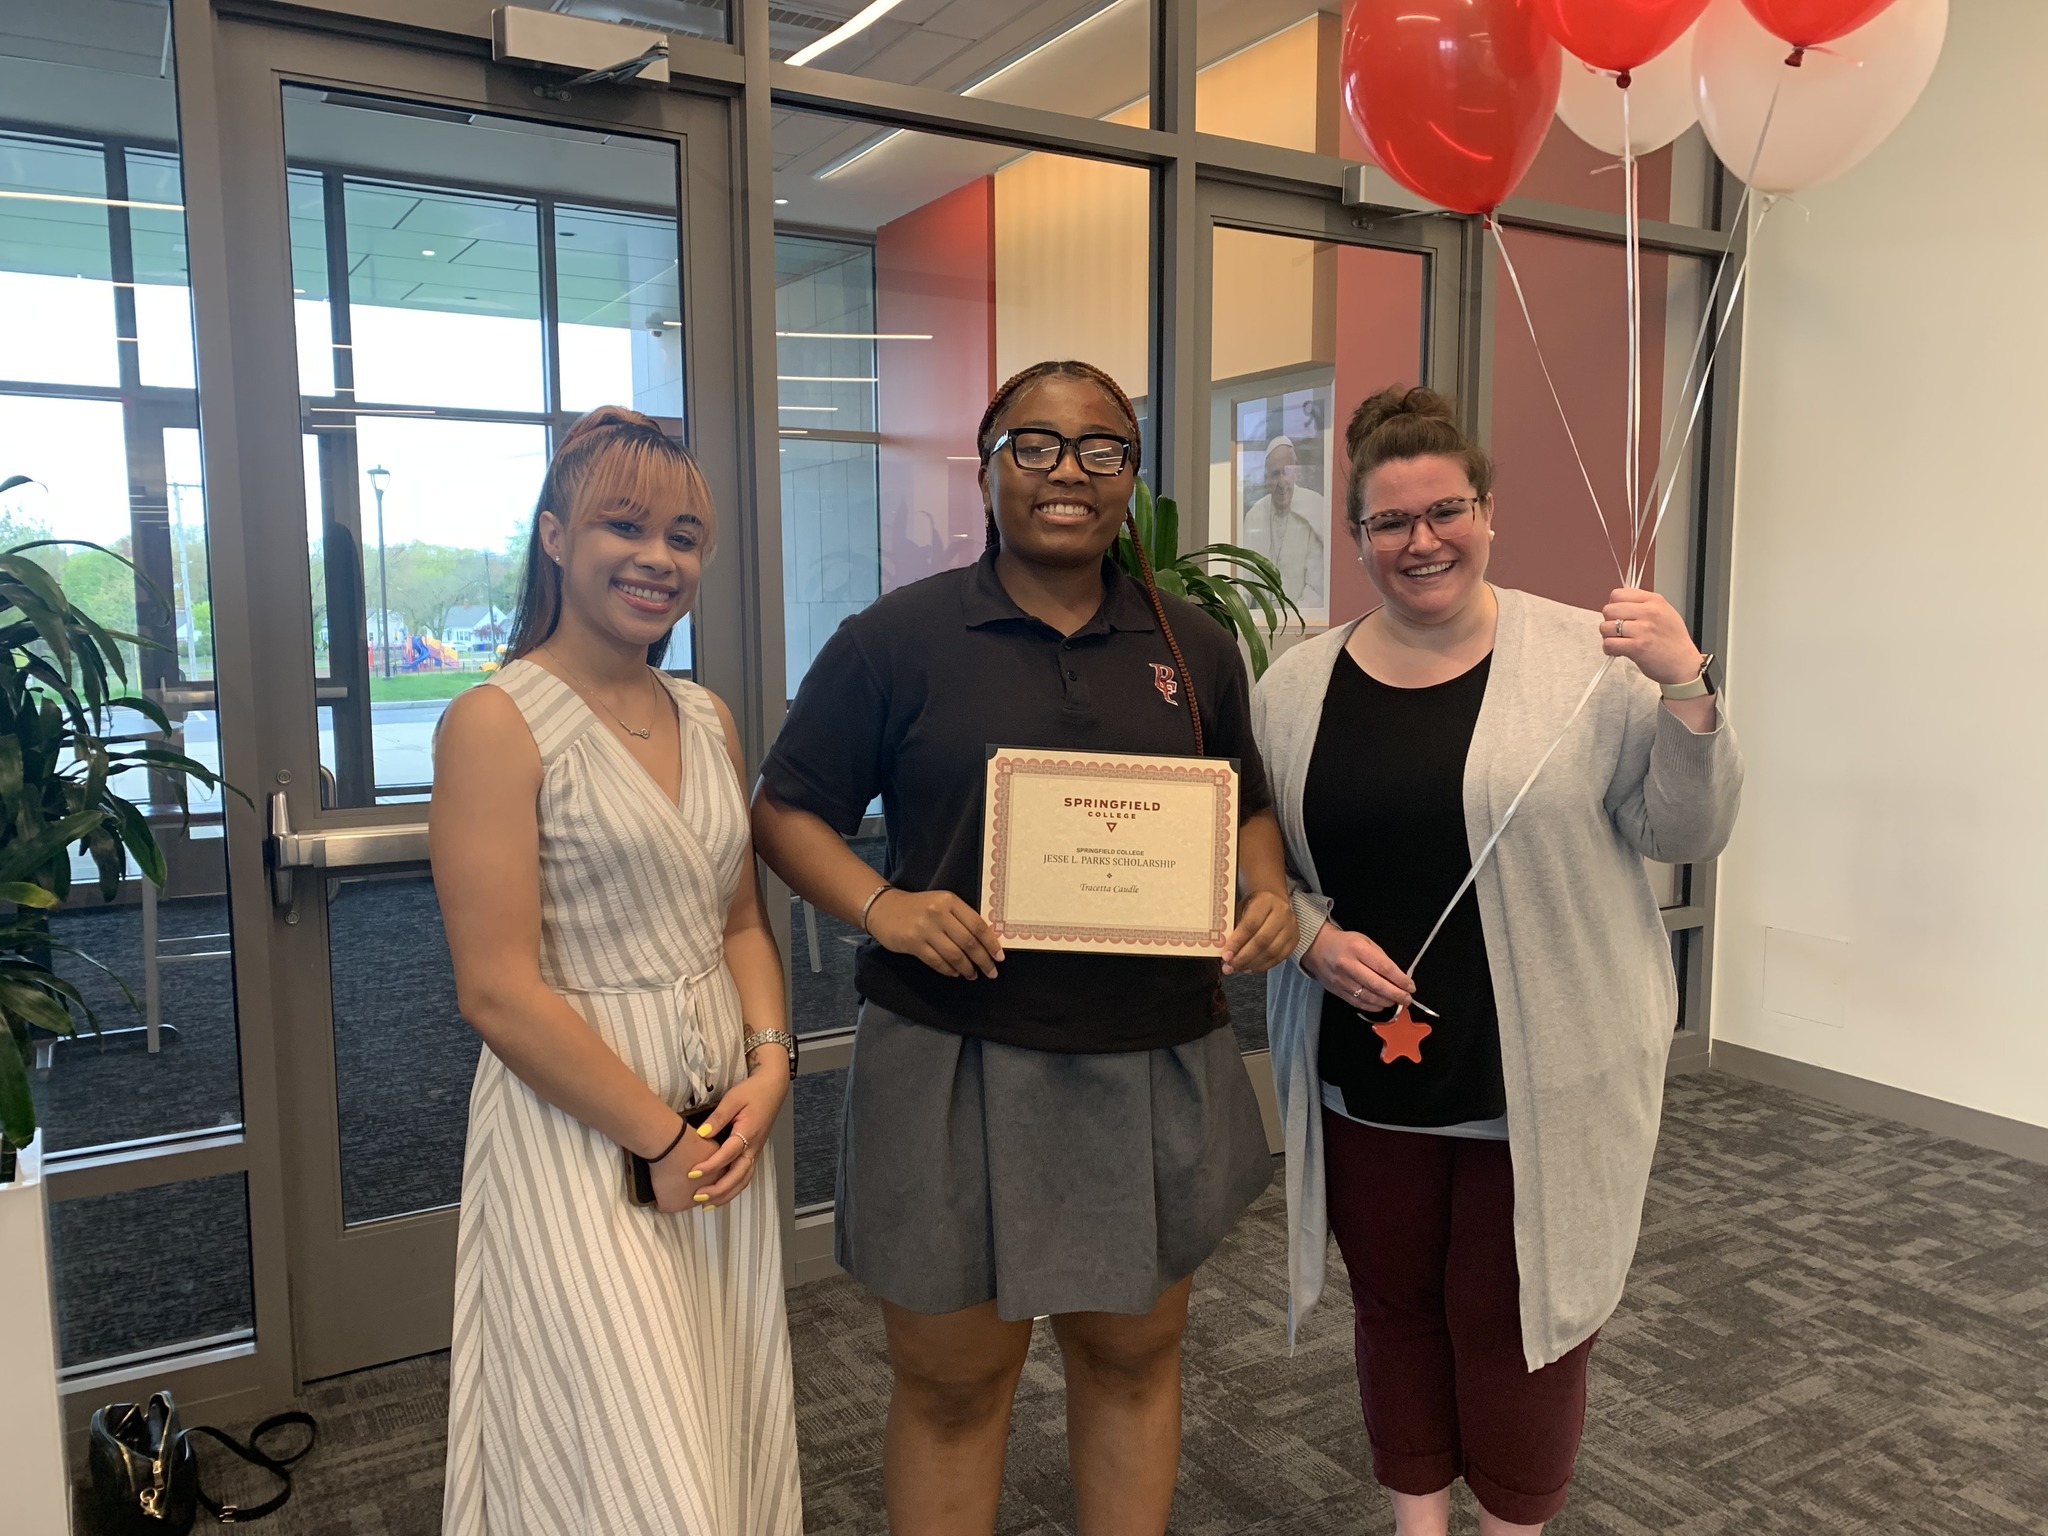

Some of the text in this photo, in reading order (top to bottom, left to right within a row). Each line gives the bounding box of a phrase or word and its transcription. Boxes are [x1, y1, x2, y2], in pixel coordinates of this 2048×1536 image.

[1064, 798, 1161, 811] SPRINGFIELD
[1087, 811, 1136, 819] COLLEGE
[1043, 854, 1176, 868] JESSE L. PARKS SCHOLARSHIP
[1080, 883, 1139, 893] Tracetta Caudle
